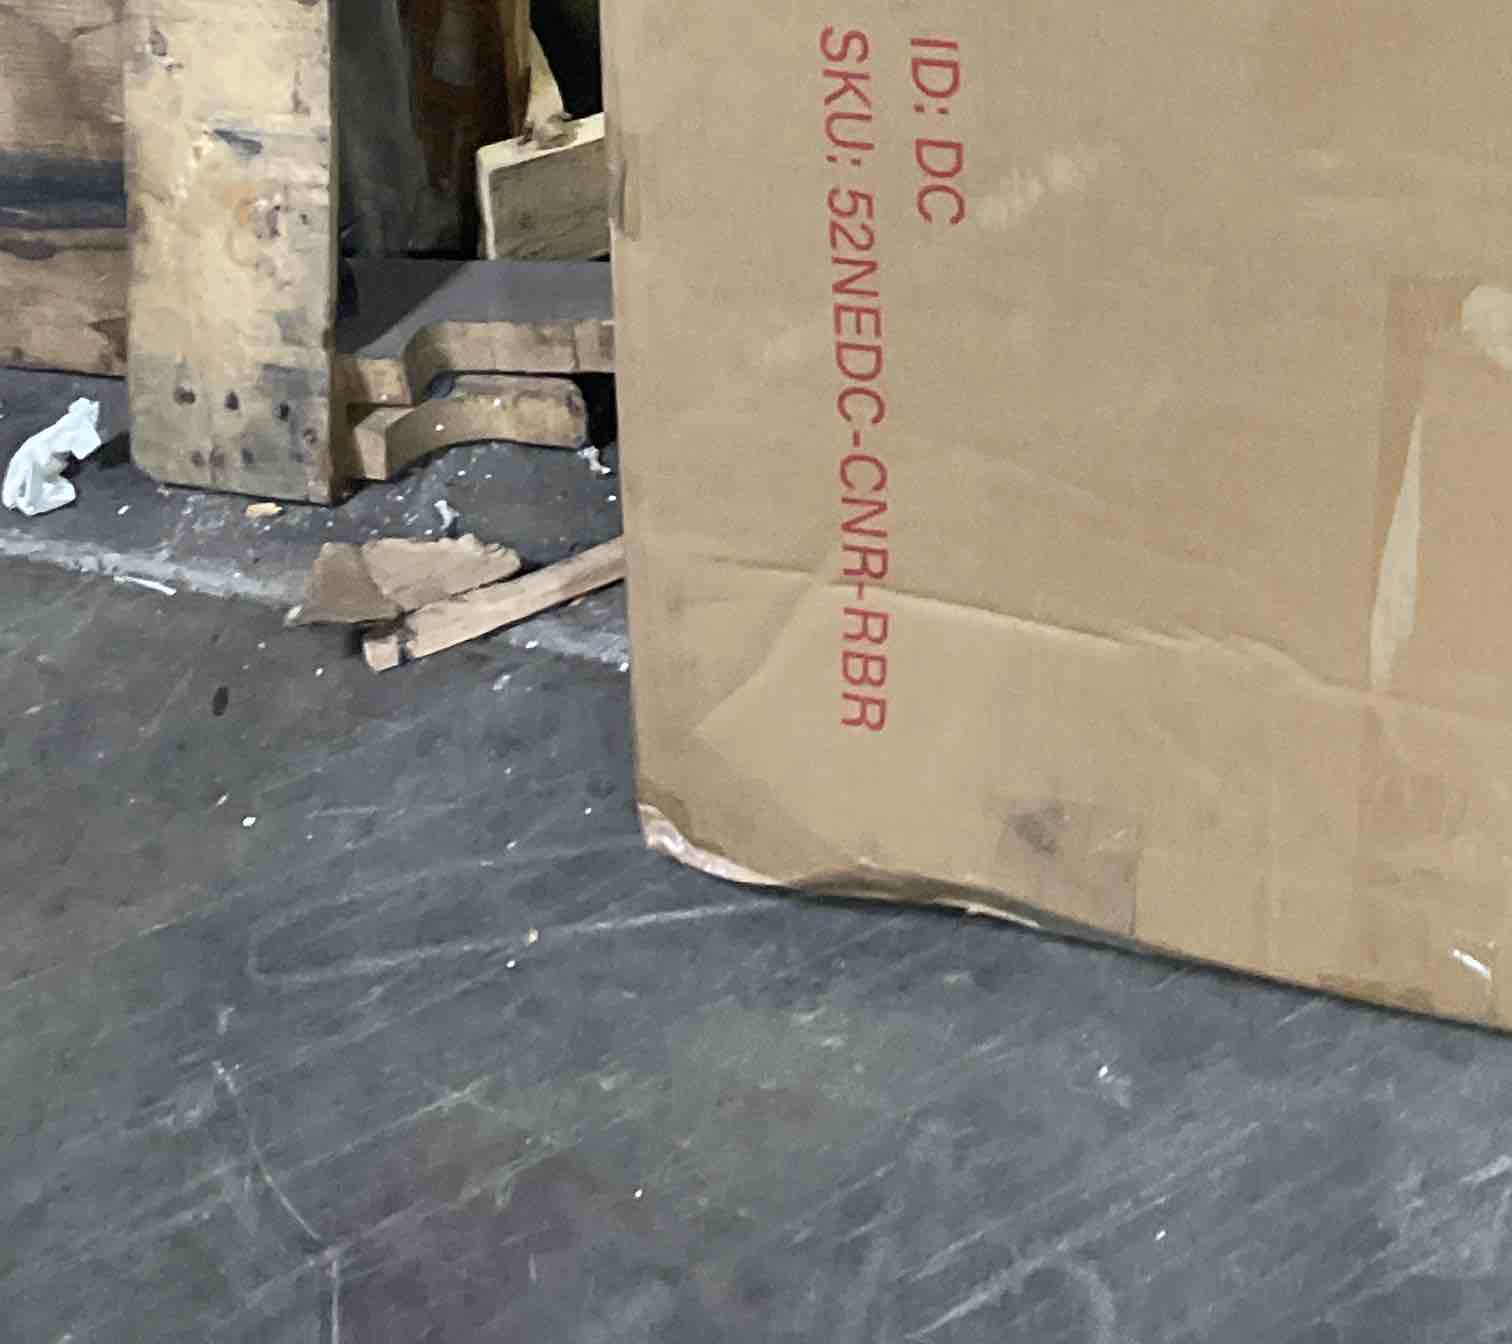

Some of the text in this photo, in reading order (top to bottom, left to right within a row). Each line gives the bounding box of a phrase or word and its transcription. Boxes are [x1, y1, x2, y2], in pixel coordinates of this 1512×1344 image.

[911, 37, 966, 226] ID: DC
[819, 25, 890, 733] SKU: 52NEDC-CNR-RBR
